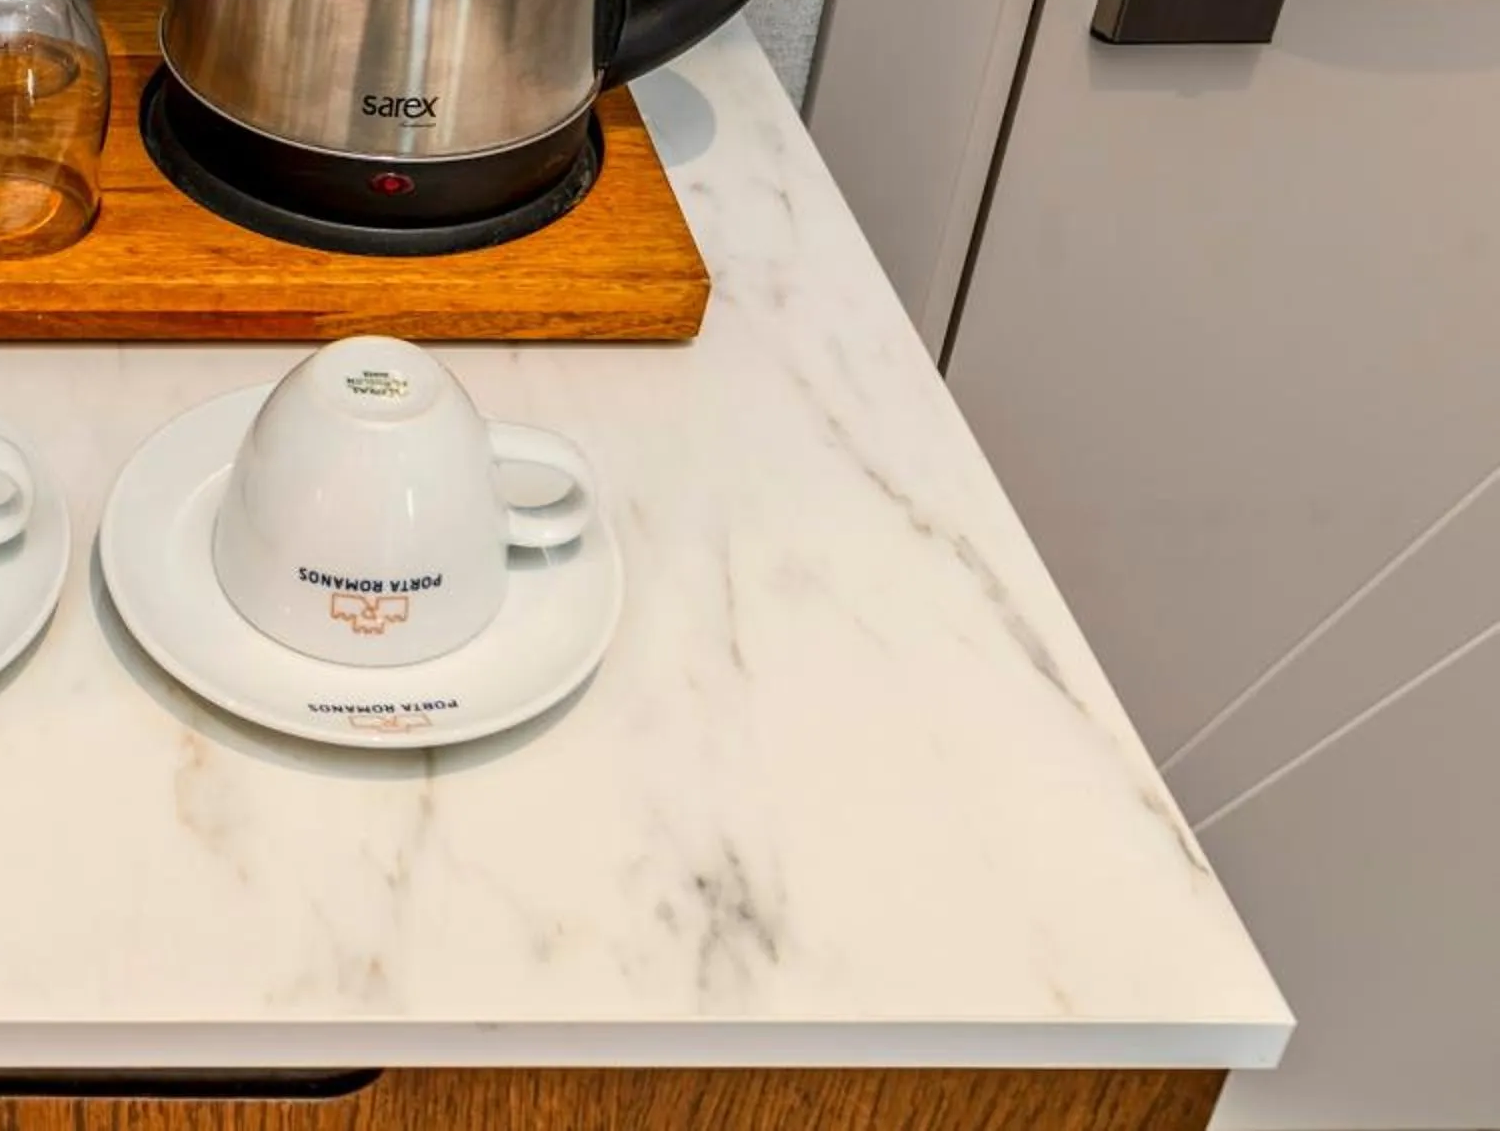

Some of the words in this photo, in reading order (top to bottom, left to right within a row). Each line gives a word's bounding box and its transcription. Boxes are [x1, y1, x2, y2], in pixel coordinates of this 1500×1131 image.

[362, 95, 439, 118] sarex
[298, 567, 384, 594] ROMANOS
[390, 573, 443, 593] PORTA
[307, 702, 396, 715] ROMANOS
[400, 699, 459, 713] PORTA
